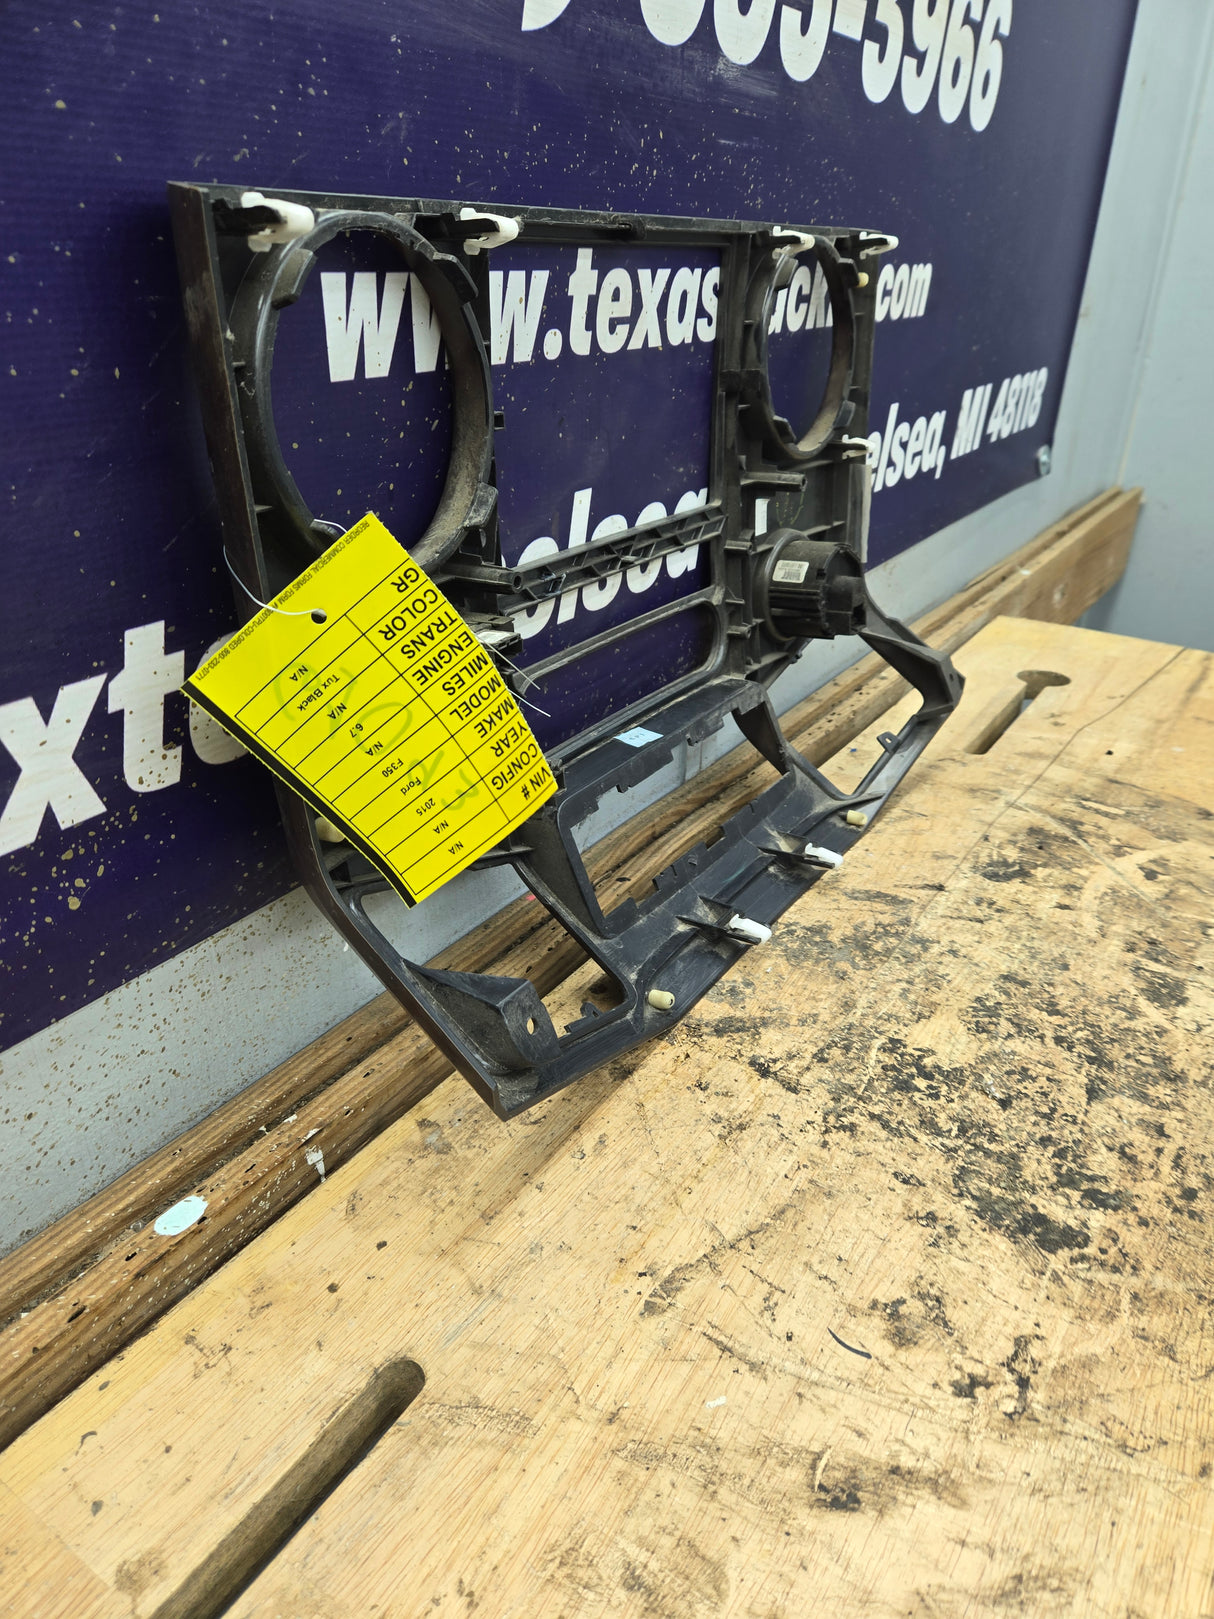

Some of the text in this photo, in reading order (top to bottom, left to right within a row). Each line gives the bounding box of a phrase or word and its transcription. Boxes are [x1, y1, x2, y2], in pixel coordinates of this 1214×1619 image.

[949, 382, 994, 461] MI
[986, 366, 1049, 443] 48118
[313, 540, 346, 575] COMMERCIAL
[345, 520, 371, 547] REORDER
[277, 585, 295, 605] FORM
[289, 567, 420, 682] GR N/A
[292, 571, 313, 593] FORMS
[297, 589, 438, 712] COLOR Tux Black
[327, 611, 458, 720] TRANS N/A
[349, 630, 474, 738] ENGINE 6.7
[364, 652, 489, 756] MILES N/A
[381, 673, 501, 778] MODEL F350
[400, 696, 514, 796] MAKE Ford
[415, 721, 528, 817] YEAR 2015
[432, 743, 538, 834] CONFIG N/A
[529, 766, 551, 792] VIN
[448, 840, 464, 855] N/A
